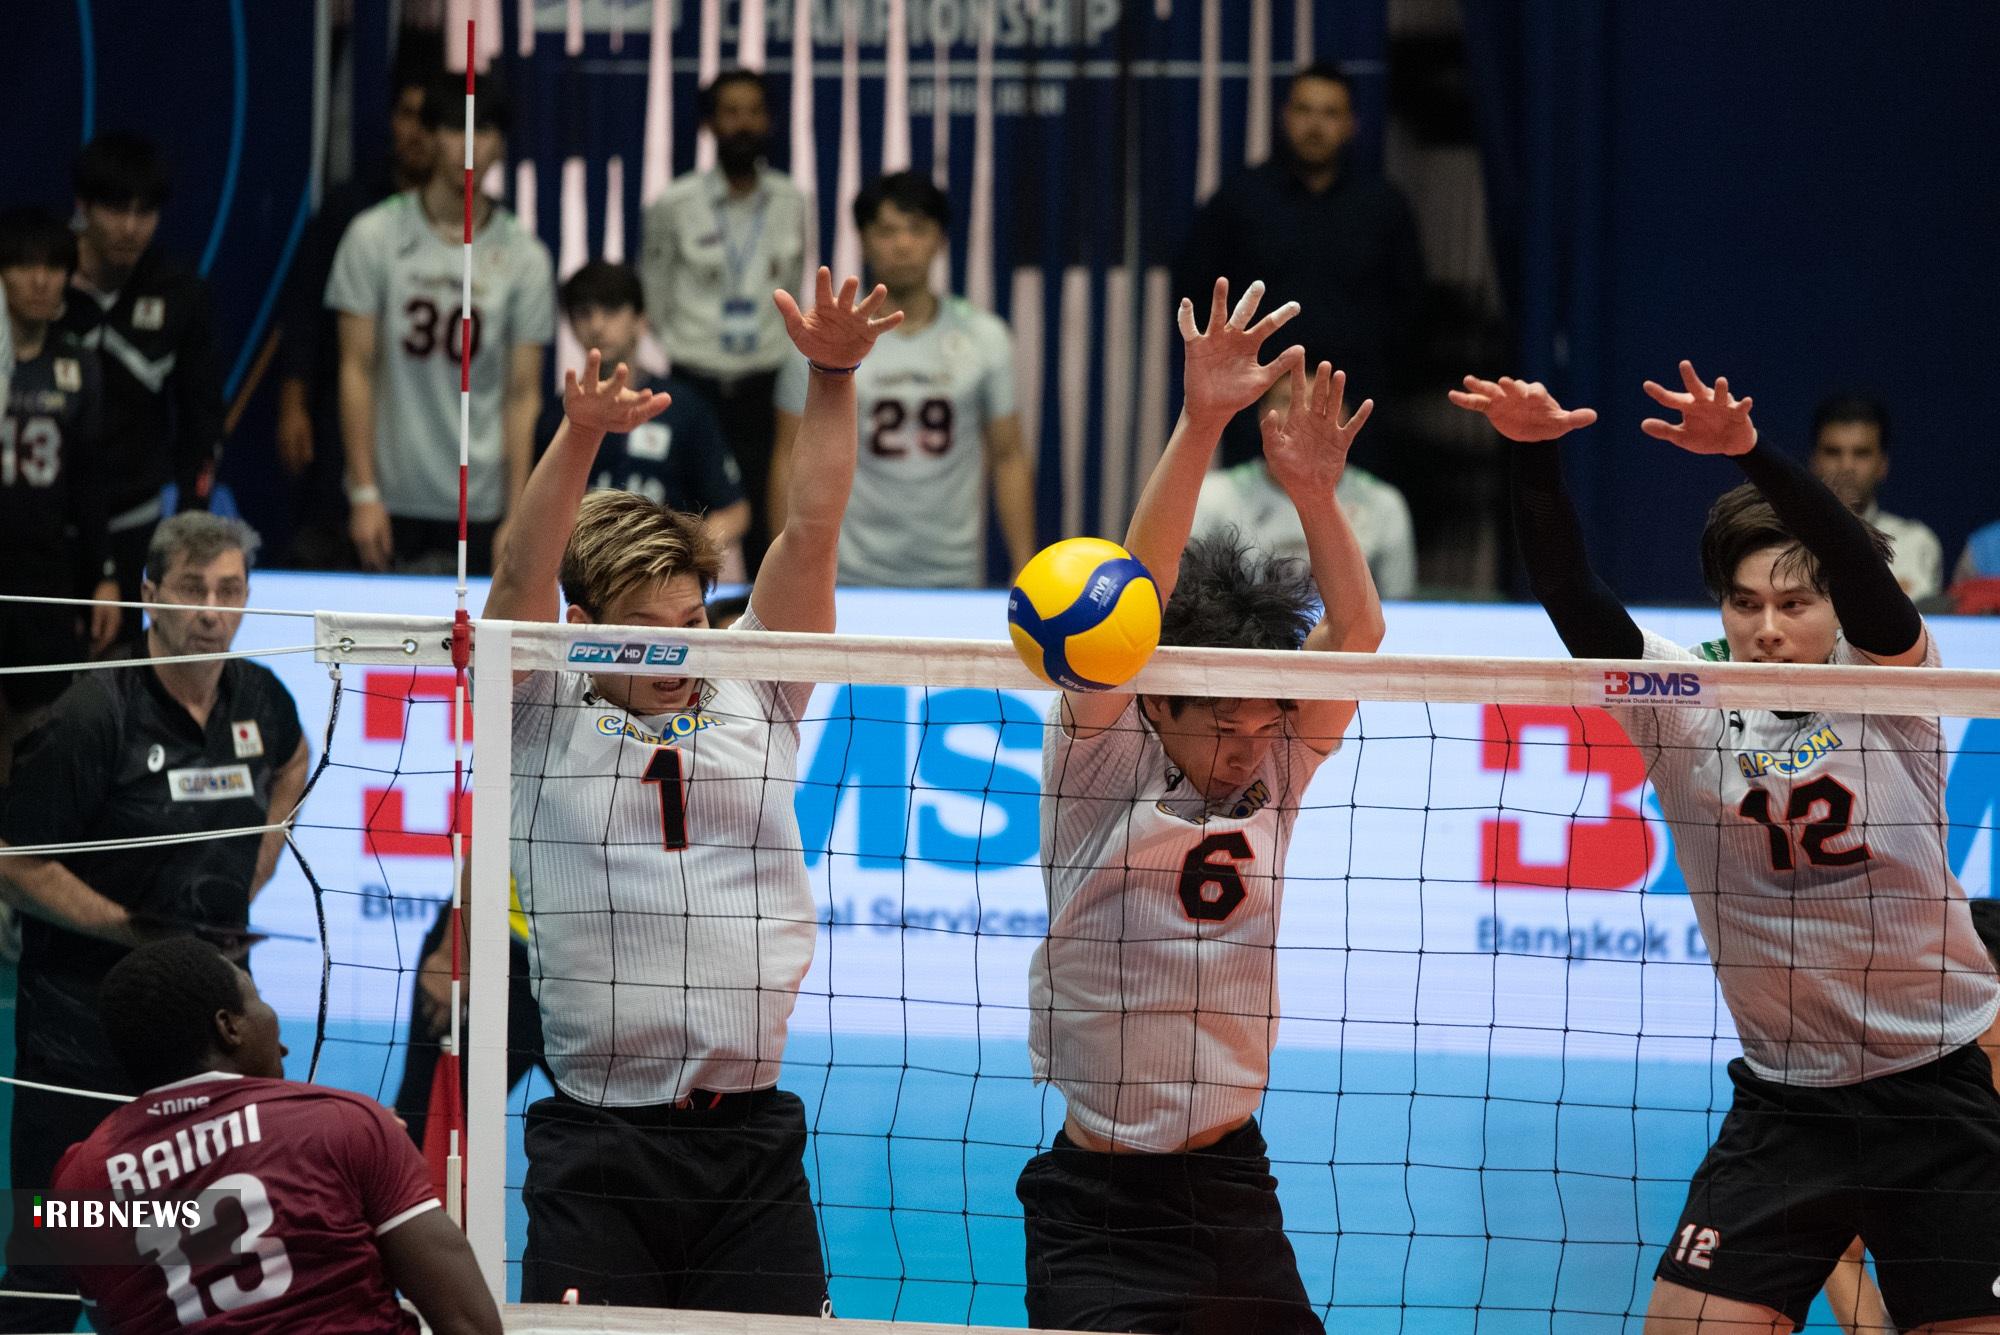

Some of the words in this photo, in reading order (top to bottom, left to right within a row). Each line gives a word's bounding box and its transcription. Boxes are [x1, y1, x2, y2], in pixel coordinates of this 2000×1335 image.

[403, 296, 482, 364] 30
[0, 415, 61, 486] 13
[870, 397, 953, 457] 29
[571, 644, 622, 661] PPTV
[624, 648, 641, 659] HD
[651, 646, 681, 661] 36
[1604, 671, 1700, 696] BDMS
[1605, 697, 1631, 705] Bangkok
[641, 745, 689, 852] 1
[1737, 772, 1873, 873] 12
[1177, 829, 1255, 924] 6
[871, 897, 1048, 936] Services
[1477, 915, 1667, 966] Bangkok
[162, 1095, 211, 1116] nine
[106, 1103, 261, 1203] RAIMI
[135, 1173, 293, 1327] 13
[1675, 1223, 1720, 1270] 12
